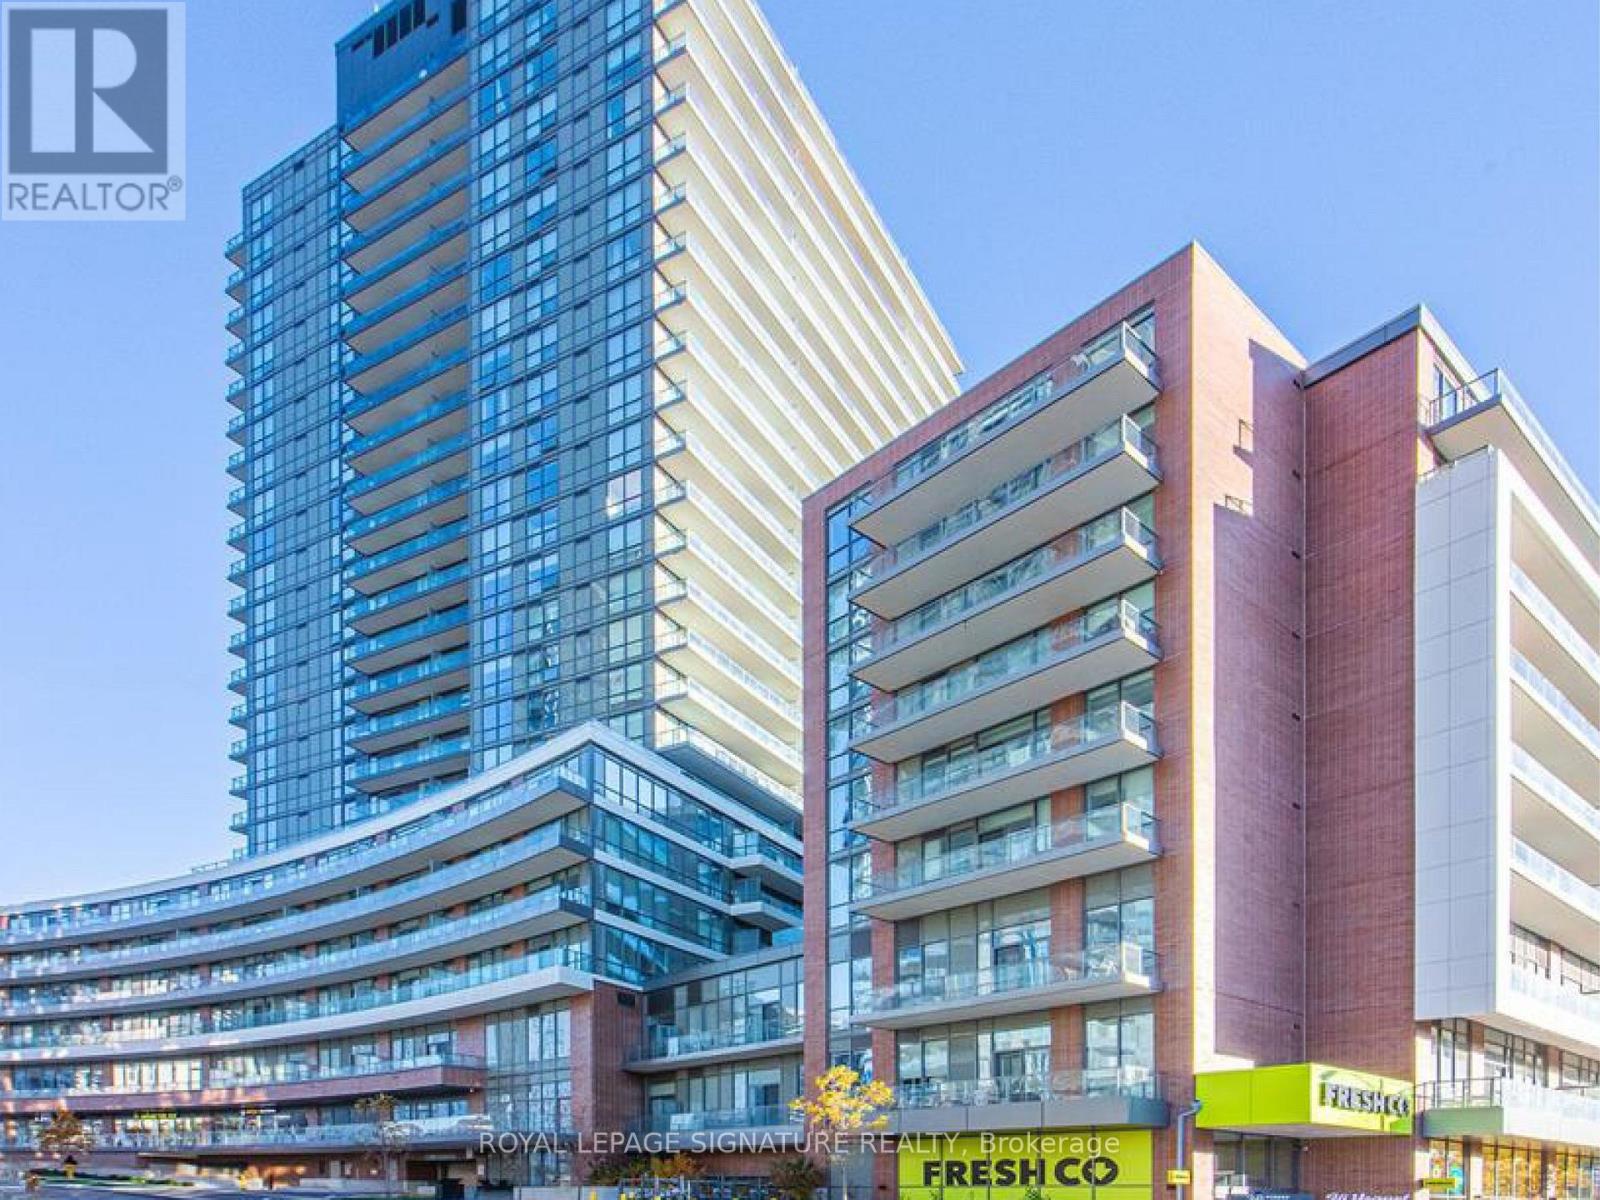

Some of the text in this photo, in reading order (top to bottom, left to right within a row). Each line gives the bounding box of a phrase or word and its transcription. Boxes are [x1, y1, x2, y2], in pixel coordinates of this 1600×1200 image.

[1326, 1083, 1386, 1113] FRESH
[922, 1156, 1119, 1187] FRESH CO
